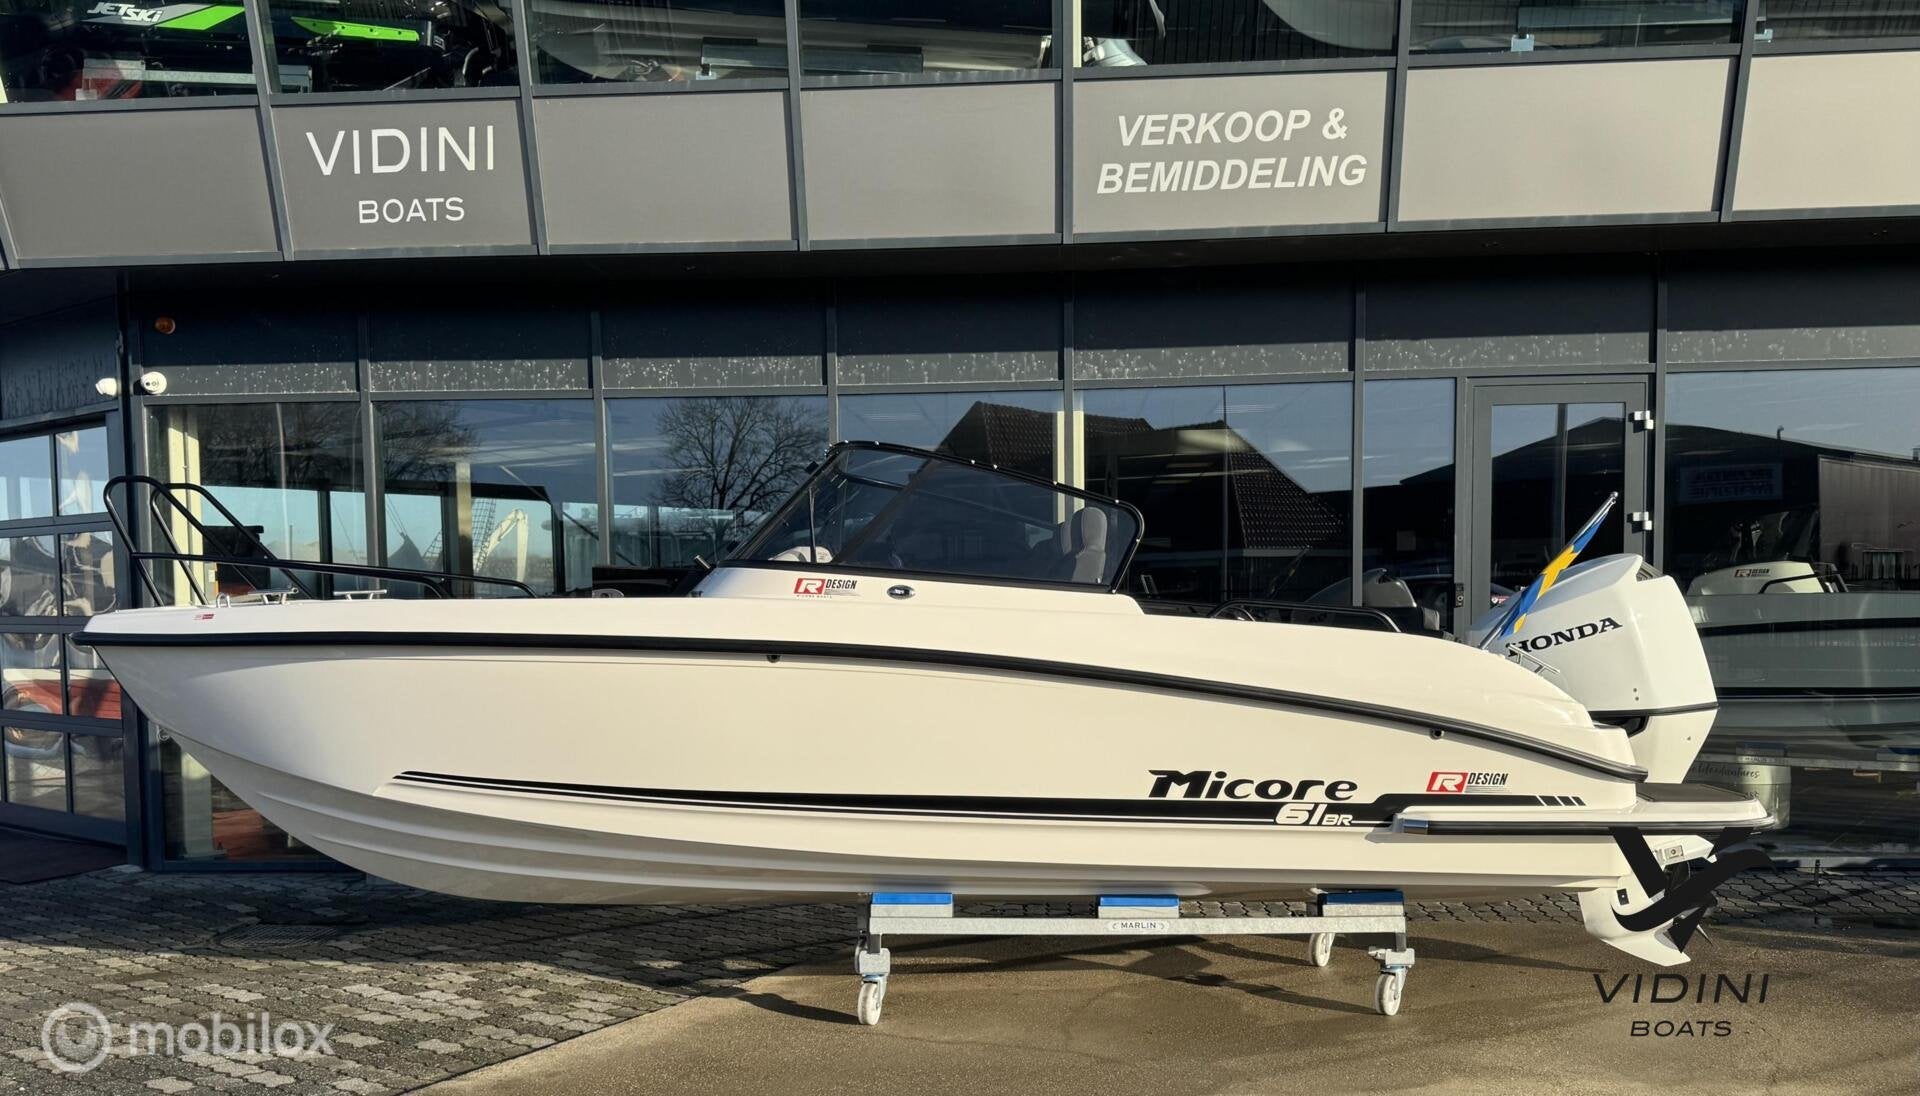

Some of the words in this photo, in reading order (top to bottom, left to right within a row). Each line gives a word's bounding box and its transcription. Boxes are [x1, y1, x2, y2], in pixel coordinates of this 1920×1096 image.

[1118, 109, 1311, 146] VERKOOP
[1322, 107, 1348, 140] &
[305, 125, 494, 176] VIDINI
[1097, 154, 1368, 194] BEMIDDELING
[358, 196, 465, 224] BOATS
[826, 578, 857, 590] DESIGN
[1148, 769, 1358, 801] Micore
[1467, 772, 1508, 785] DESIGN
